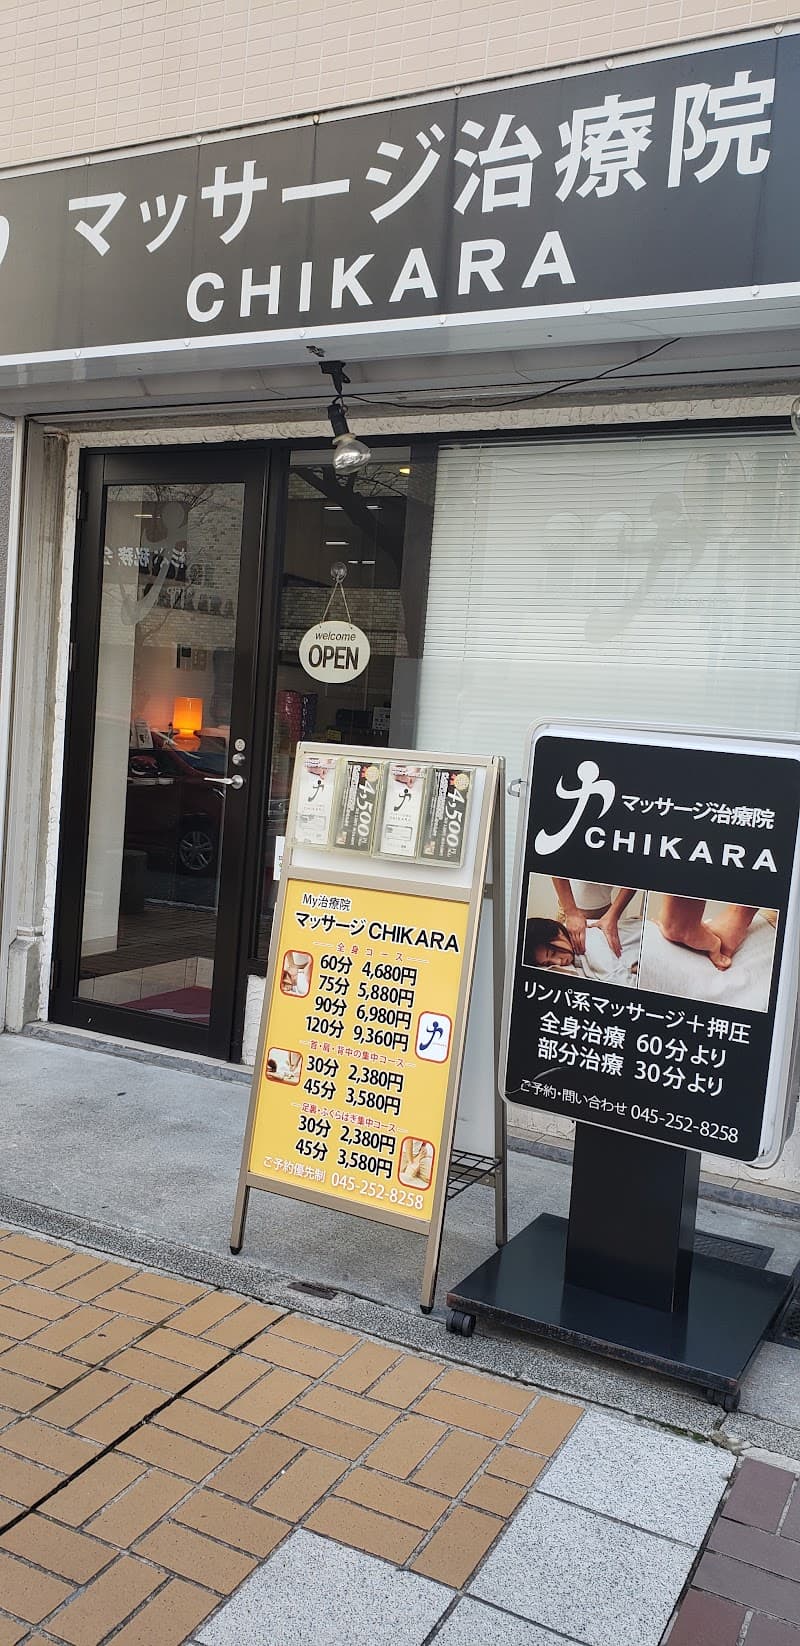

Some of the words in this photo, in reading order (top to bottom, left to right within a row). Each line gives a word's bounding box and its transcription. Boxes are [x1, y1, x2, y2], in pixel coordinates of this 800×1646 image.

[68, 70, 776, 256] マッサージ治療院
[186, 230, 577, 323] CHIKARA
[315, 632, 356, 641] welcome
[308, 644, 359, 670] OPEN
[621, 794, 776, 830] マッサージ治療院
[584, 826, 778, 873] CHIKARA
[302, 893, 351, 911] My治療院
[296, 911, 366, 935] マッサージ
[368, 922, 459, 952] CHIKARA
[320, 954, 352, 974] 60分
[362, 961, 417, 986] 4,680円
[318, 975, 350, 995] 75分
[357, 982, 415, 1008] 5,880円
[315, 995, 347, 1016] 90分
[356, 1004, 412, 1030] 6,980円
[524, 981, 751, 1044] リンパ系マッサージ＋押圧
[305, 1016, 344, 1038] 120分
[353, 1026, 409, 1052] 9,360円
[539, 1011, 626, 1050] 全身治療
[636, 1033, 726, 1069] 60分より
[307, 1056, 339, 1077] 30分
[348, 1064, 403, 1092] 2,380円
[537, 1037, 624, 1077] 部分治療
[633, 1060, 724, 1097] 30分より
[303, 1078, 336, 1100] 45分
[345, 1087, 401, 1115] 3,580円
[520, 1079, 627, 1116] ご予約・問い合わせ
[630, 1104, 738, 1143] 045-252-8258
[298, 1115, 331, 1138] 30分
[340, 1126, 396, 1155] 2,380円
[295, 1138, 328, 1162] 45分
[337, 1150, 393, 1178] 3,580円
[263, 1156, 326, 1182] ご予約優先制
[331, 1171, 424, 1209] 045-252-8258
